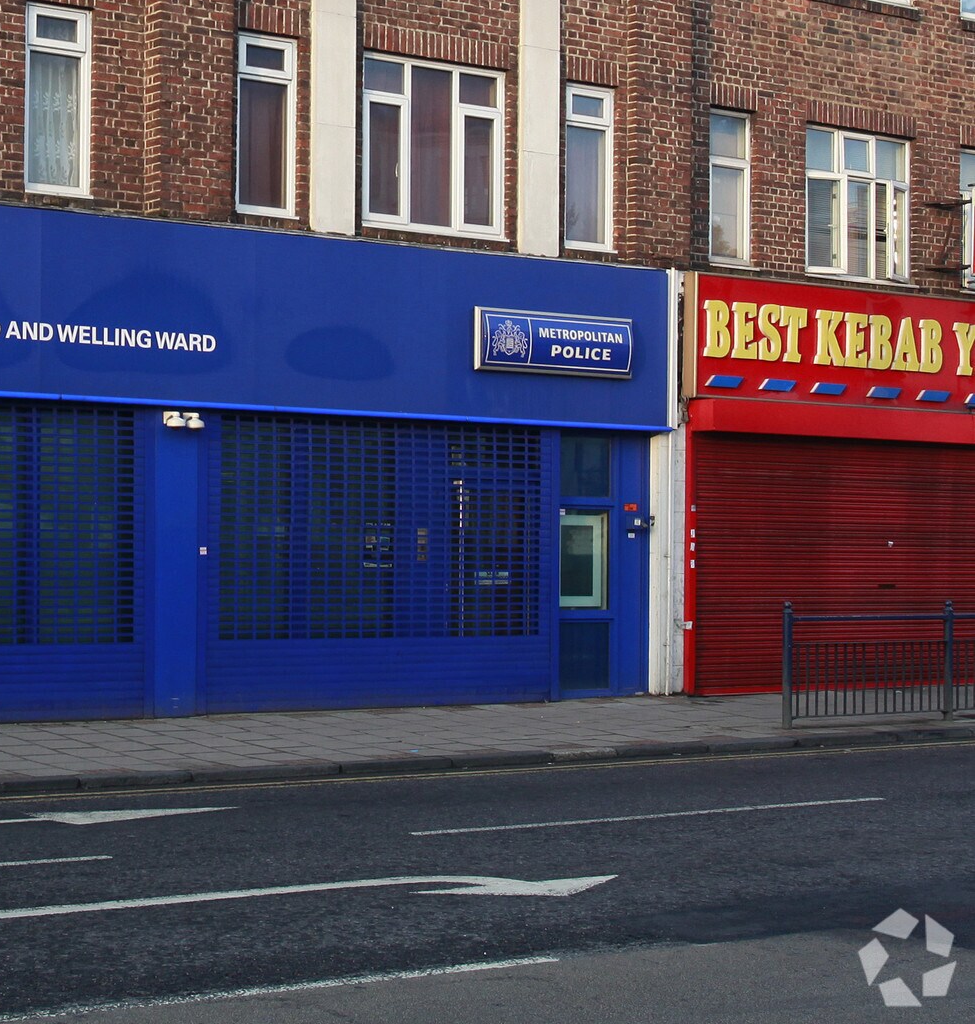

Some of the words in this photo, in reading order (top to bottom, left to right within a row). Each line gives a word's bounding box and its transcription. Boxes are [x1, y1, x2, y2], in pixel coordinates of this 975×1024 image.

[5, 320, 54, 342] AND
[57, 324, 152, 349] WELLING
[155, 331, 217, 353] WARD
[538, 327, 623, 344] METROPOLITAN
[703, 299, 808, 364] BEST
[813, 309, 944, 374] KEBAB
[550, 344, 612, 361] POLICE
